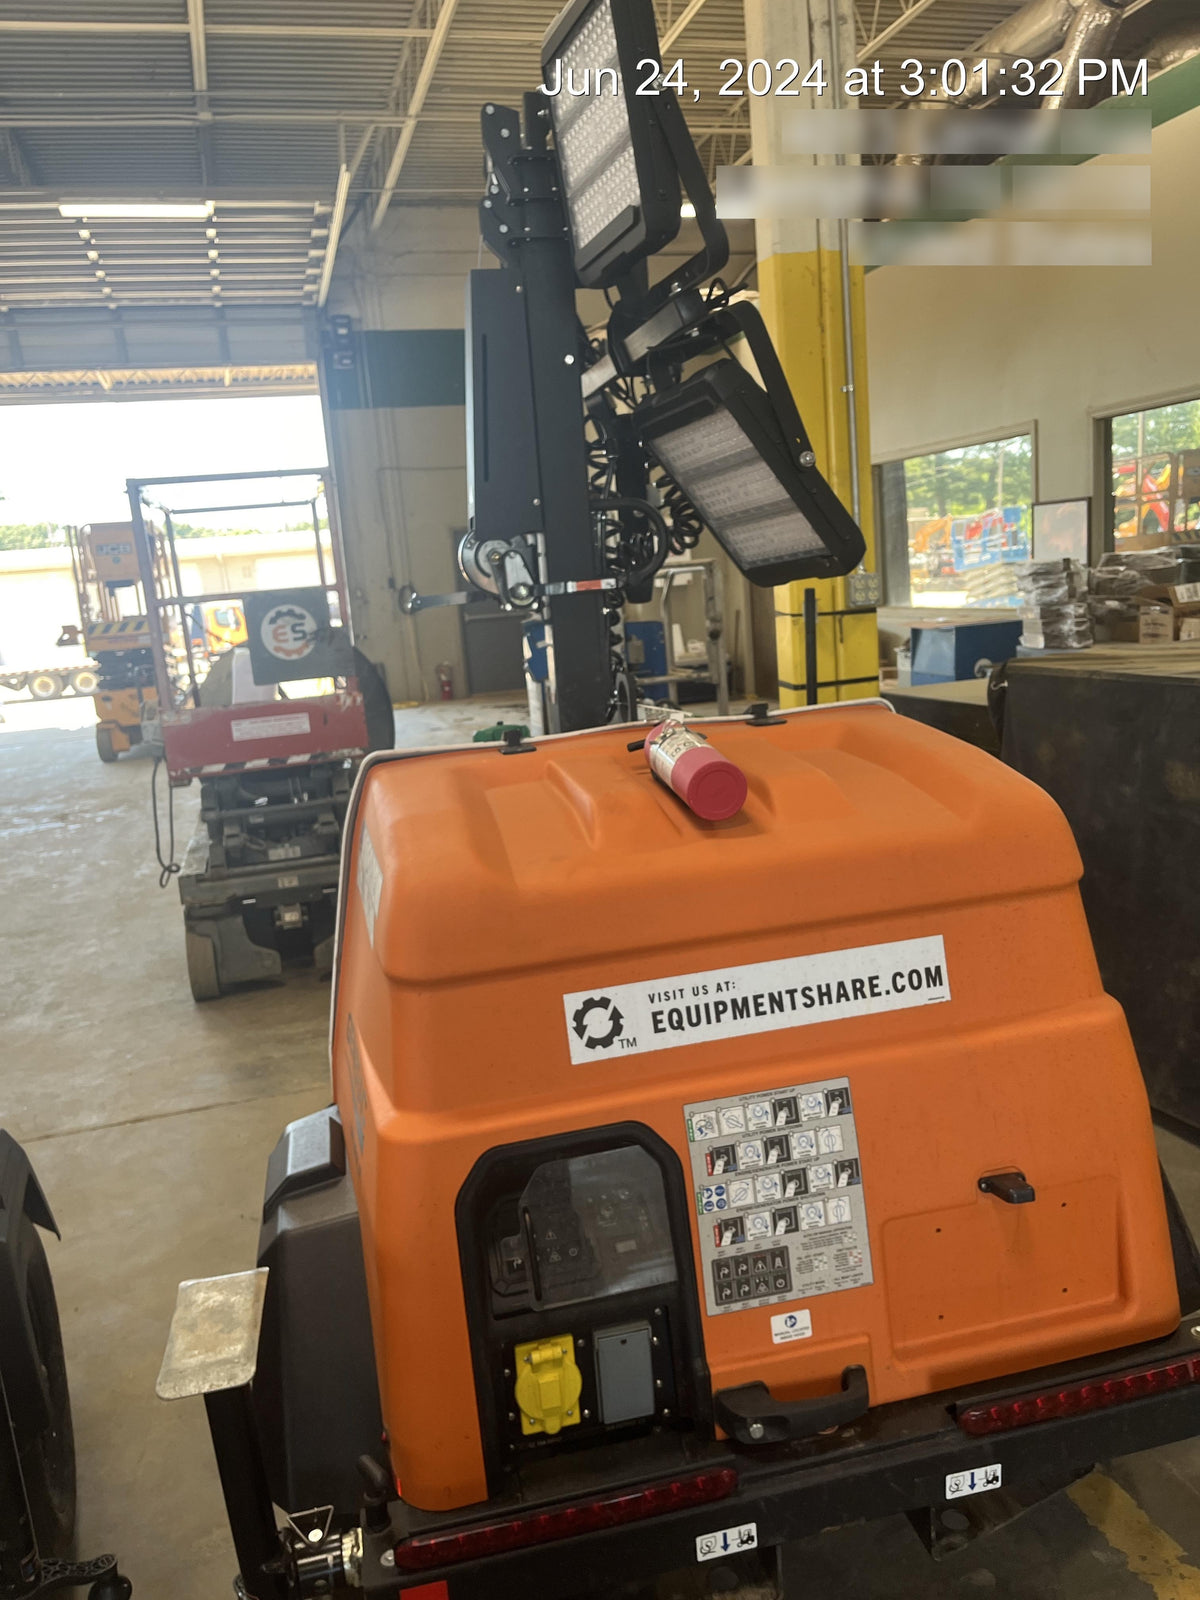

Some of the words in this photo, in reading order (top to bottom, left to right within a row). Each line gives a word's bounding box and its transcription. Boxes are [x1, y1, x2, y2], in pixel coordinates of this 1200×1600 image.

[648, 988, 685, 1004] VISIT
[692, 984, 709, 997] US
[716, 981, 736, 994] AT:
[651, 965, 944, 1034] EQUIPMENTSHARE.COM
[618, 1037, 638, 1049] TM
